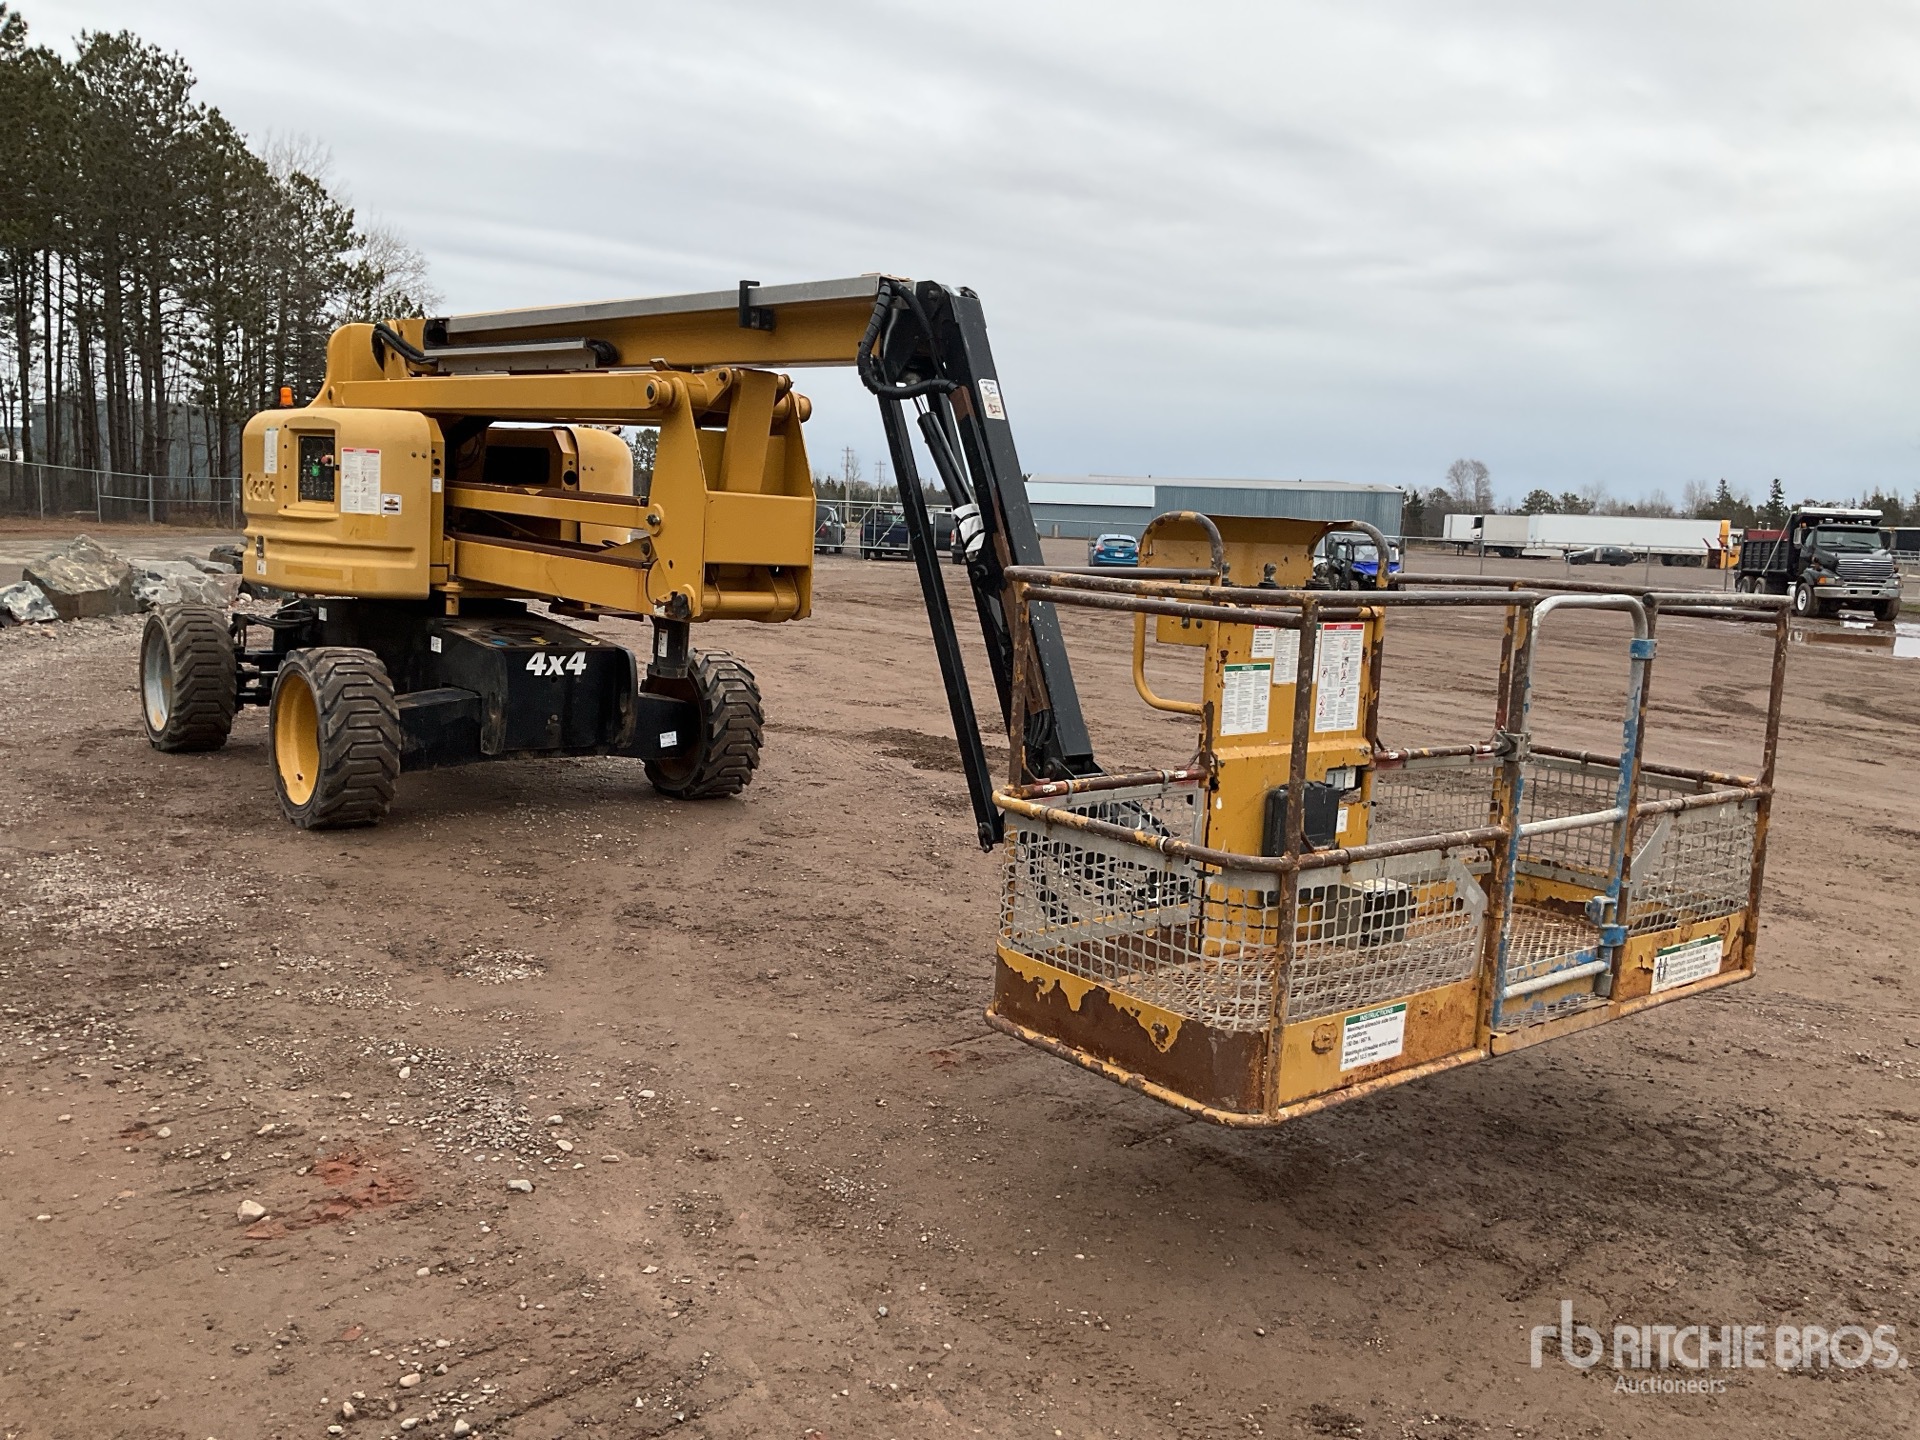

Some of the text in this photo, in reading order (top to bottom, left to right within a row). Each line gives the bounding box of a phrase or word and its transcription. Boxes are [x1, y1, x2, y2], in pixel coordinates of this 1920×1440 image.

[526, 652, 587, 676] 4x4
[1360, 1008, 1394, 1021] INSTRUCTIONS
[1347, 1024, 1364, 1032] Maximum
